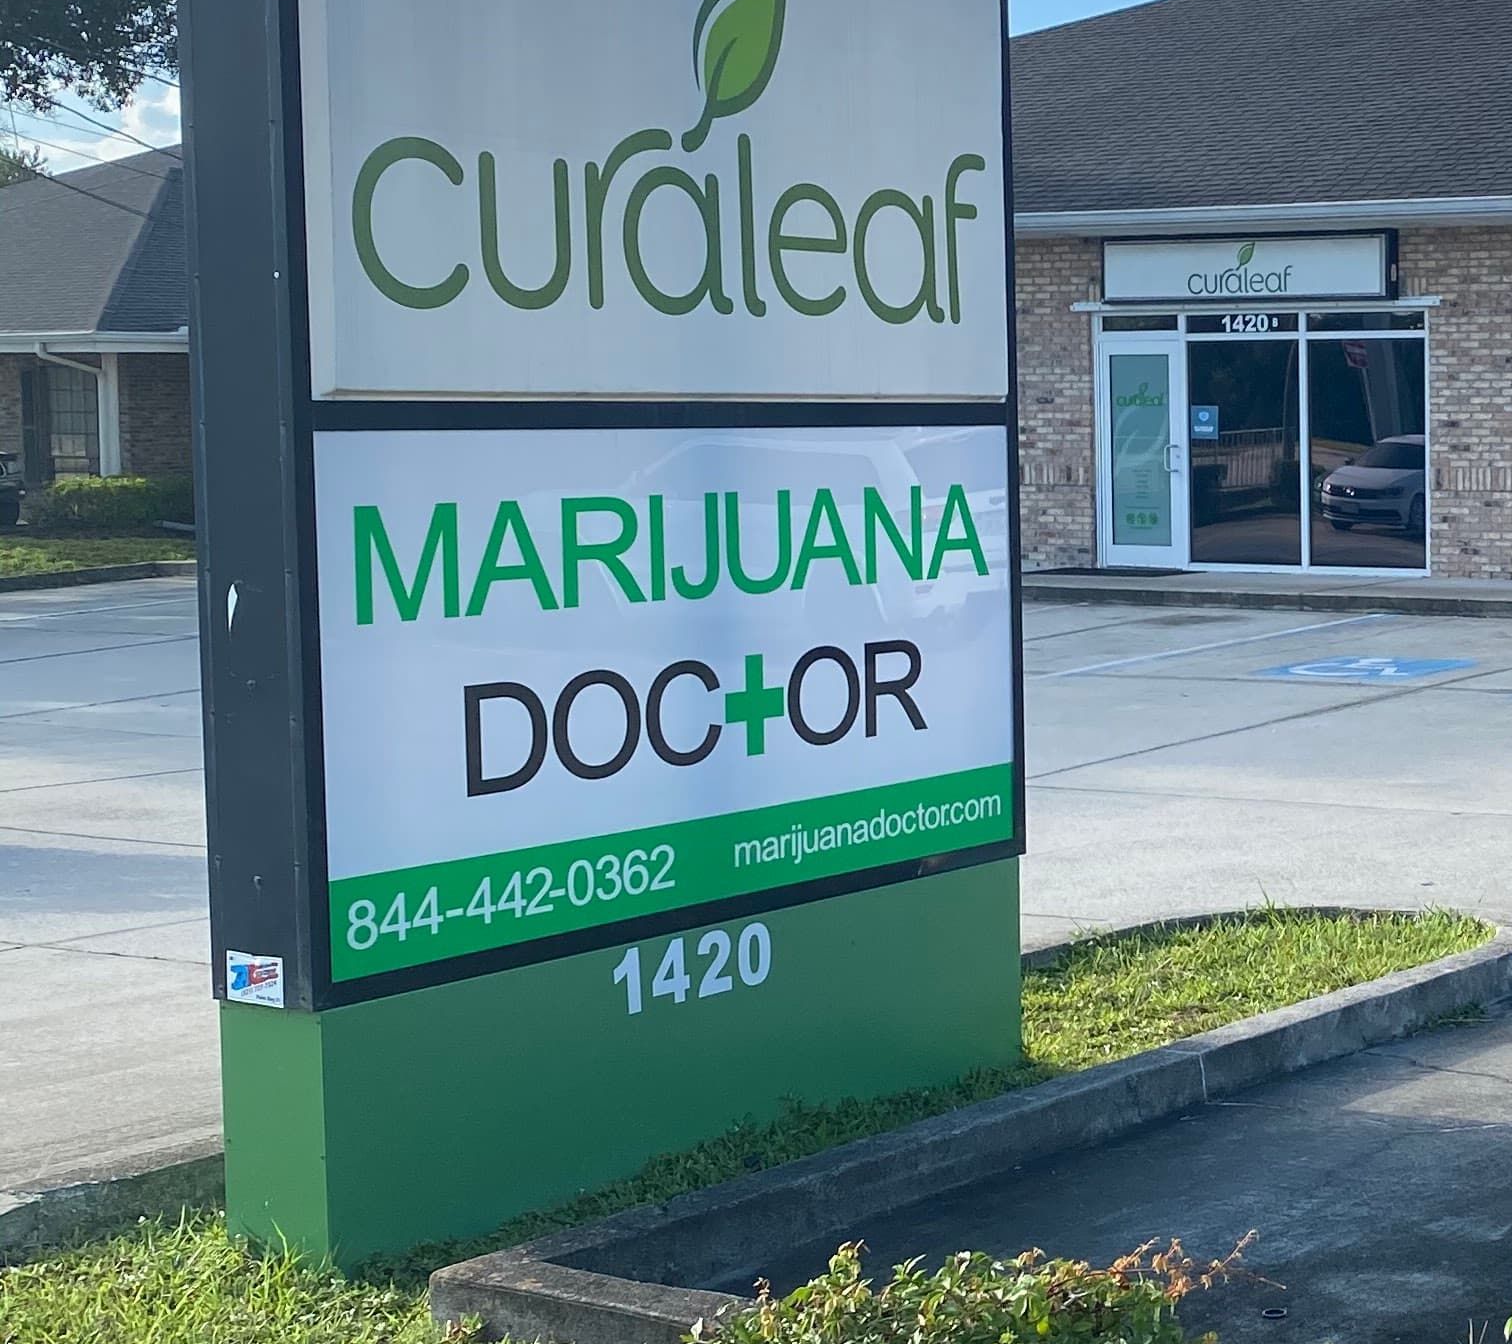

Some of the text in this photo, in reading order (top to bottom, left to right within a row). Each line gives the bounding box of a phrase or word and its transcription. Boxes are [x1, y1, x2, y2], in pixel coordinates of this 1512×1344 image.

[352, 128, 986, 326] curaleaf
[1187, 264, 1293, 295] curaleaf
[1221, 314, 1269, 333] 1420
[352, 483, 990, 627] MARIJUANA
[345, 792, 1002, 951] 844-442-0362 marijuanadoctor.com
[612, 922, 772, 1015] 1420
